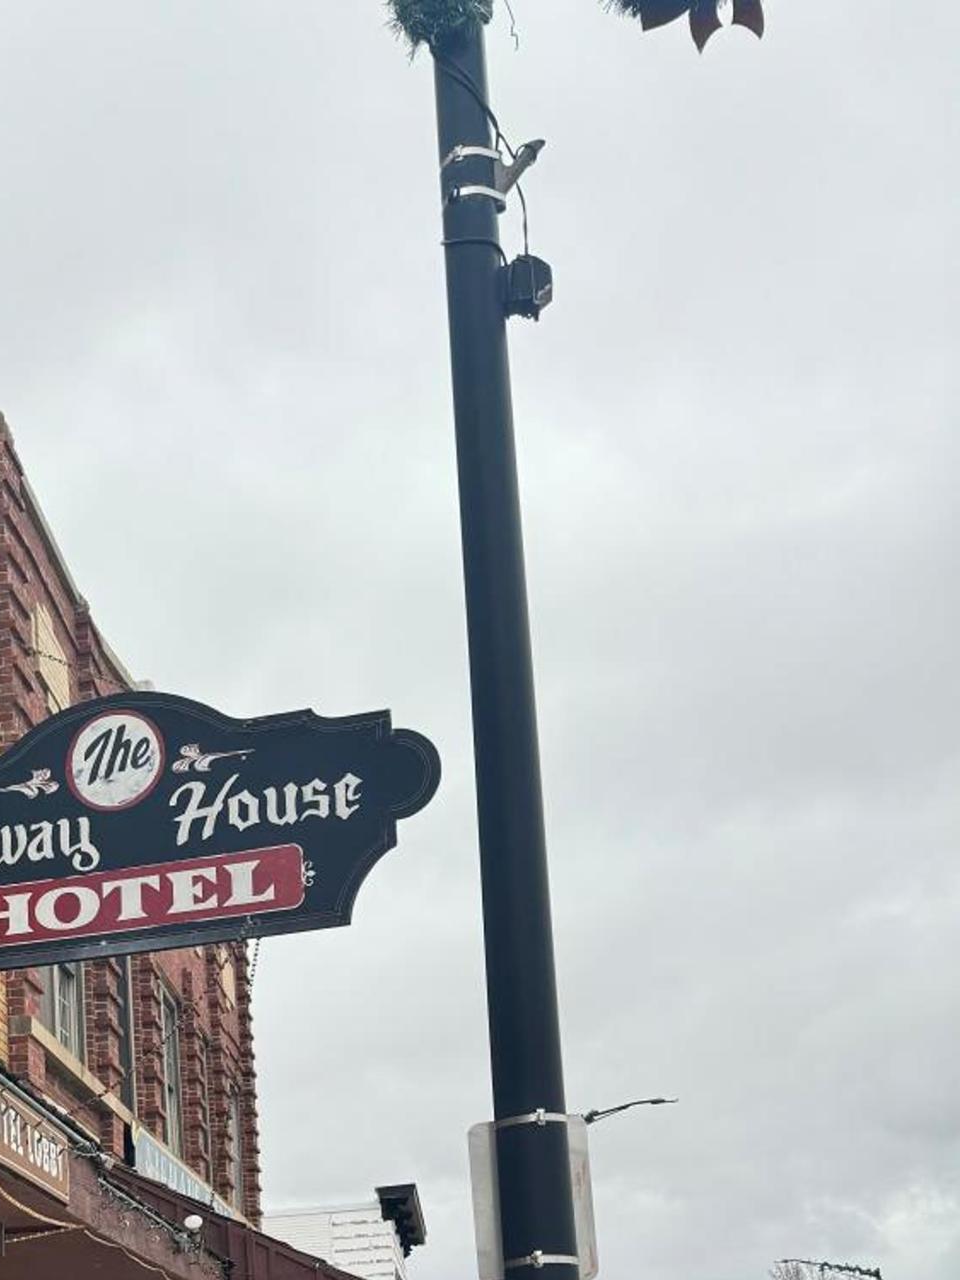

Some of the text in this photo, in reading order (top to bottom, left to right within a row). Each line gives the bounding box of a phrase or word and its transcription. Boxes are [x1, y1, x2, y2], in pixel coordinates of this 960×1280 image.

[83, 724, 152, 786] The
[168, 771, 363, 846] House
[26, 1123, 64, 1182] LOBBY
